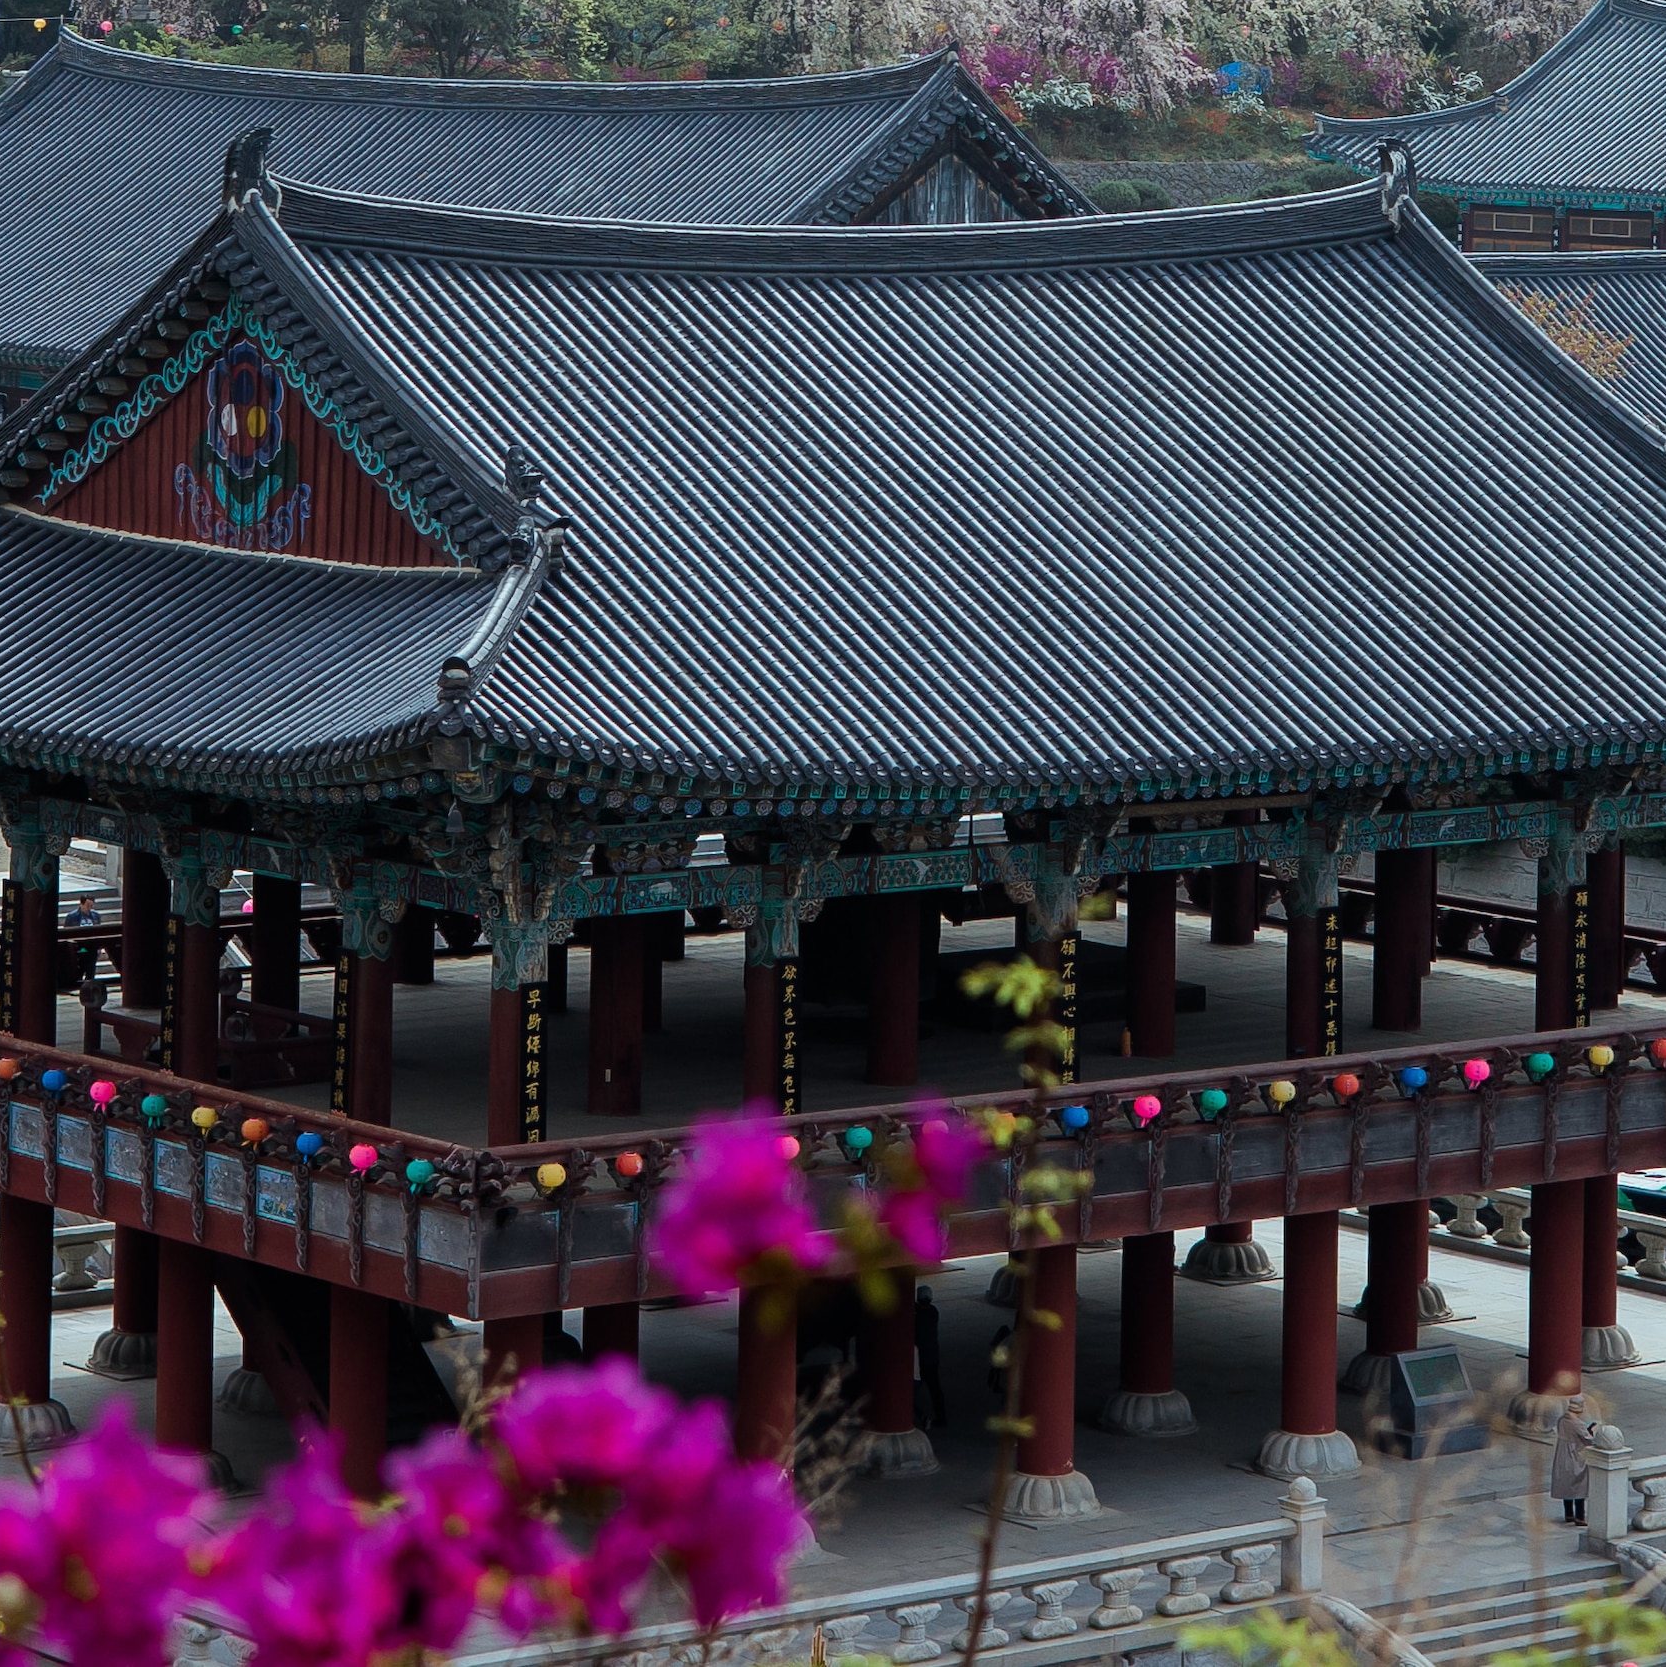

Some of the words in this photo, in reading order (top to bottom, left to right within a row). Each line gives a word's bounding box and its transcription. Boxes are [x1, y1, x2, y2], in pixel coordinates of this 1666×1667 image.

[781, 964, 798, 1117] 欲界色界無色界
